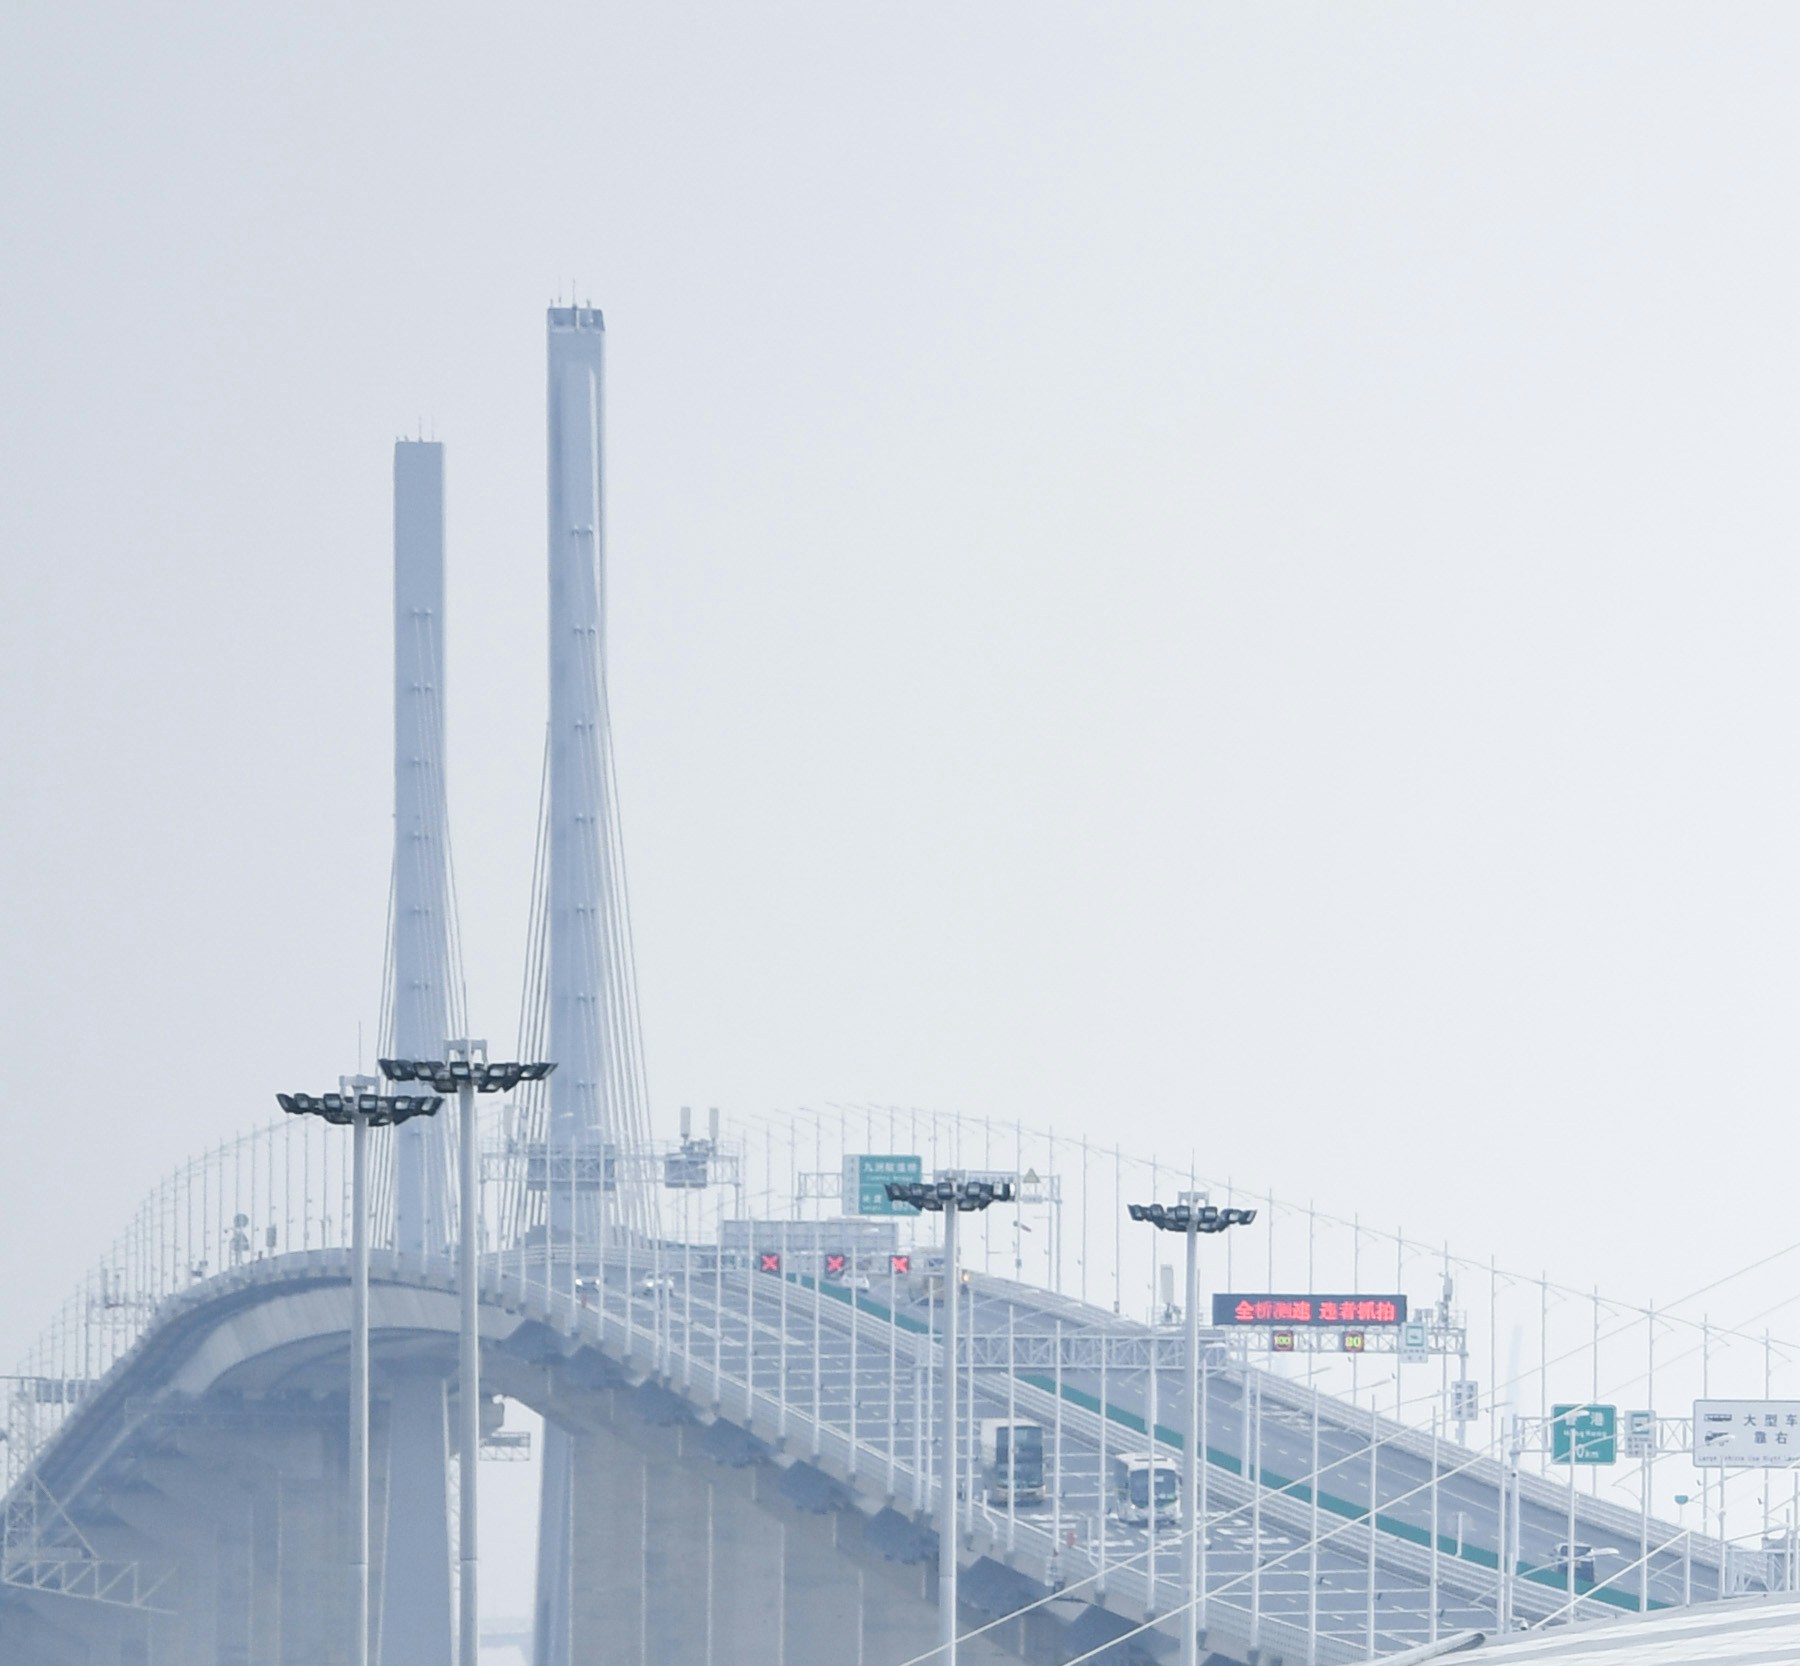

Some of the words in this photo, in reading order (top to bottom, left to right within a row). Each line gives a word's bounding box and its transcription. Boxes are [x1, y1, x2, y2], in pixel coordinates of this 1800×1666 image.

[1743, 1413, 1798, 1427] 大型车
[1754, 1431, 1788, 1445] 靠右
